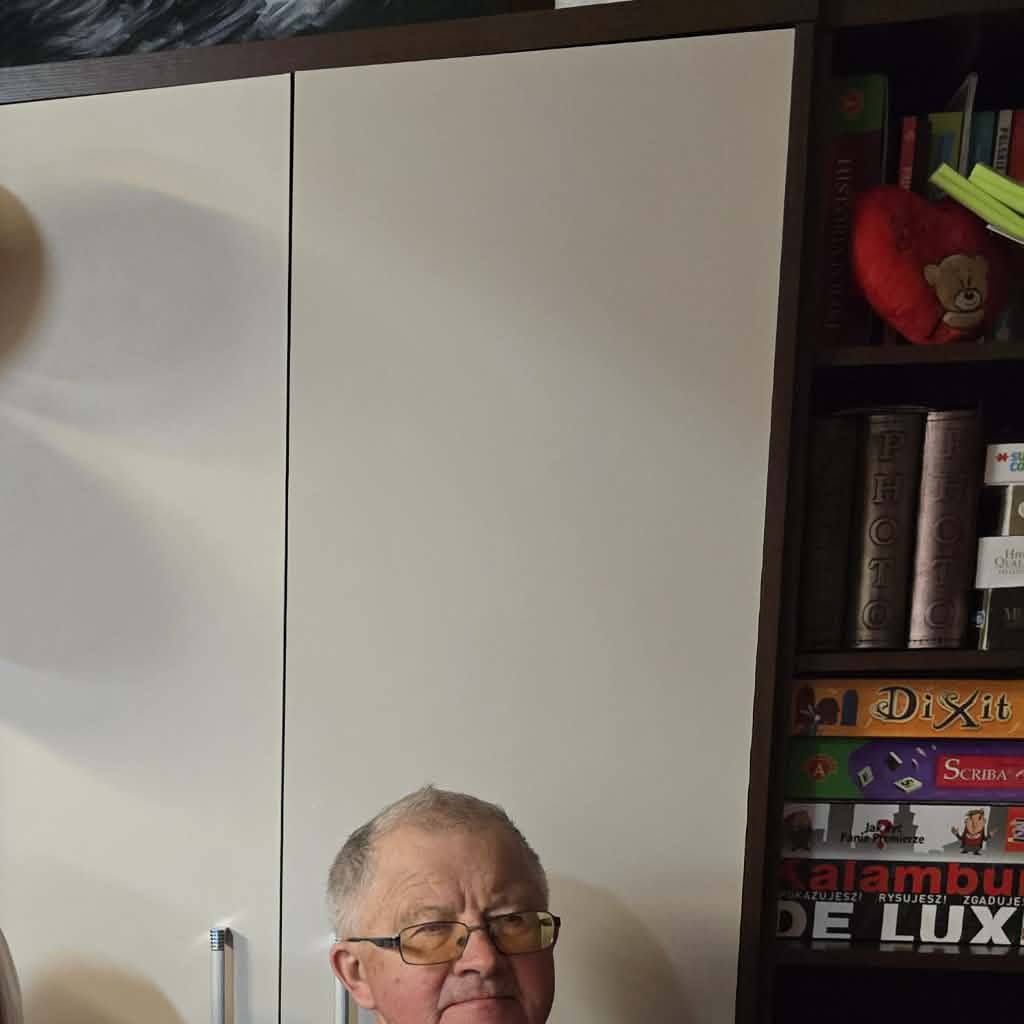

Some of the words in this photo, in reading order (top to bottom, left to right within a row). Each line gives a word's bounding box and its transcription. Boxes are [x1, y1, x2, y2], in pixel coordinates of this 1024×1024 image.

[863, 430, 904, 631] PHOTO
[777, 900, 854, 939] DE
[880, 903, 1024, 944] LUX
